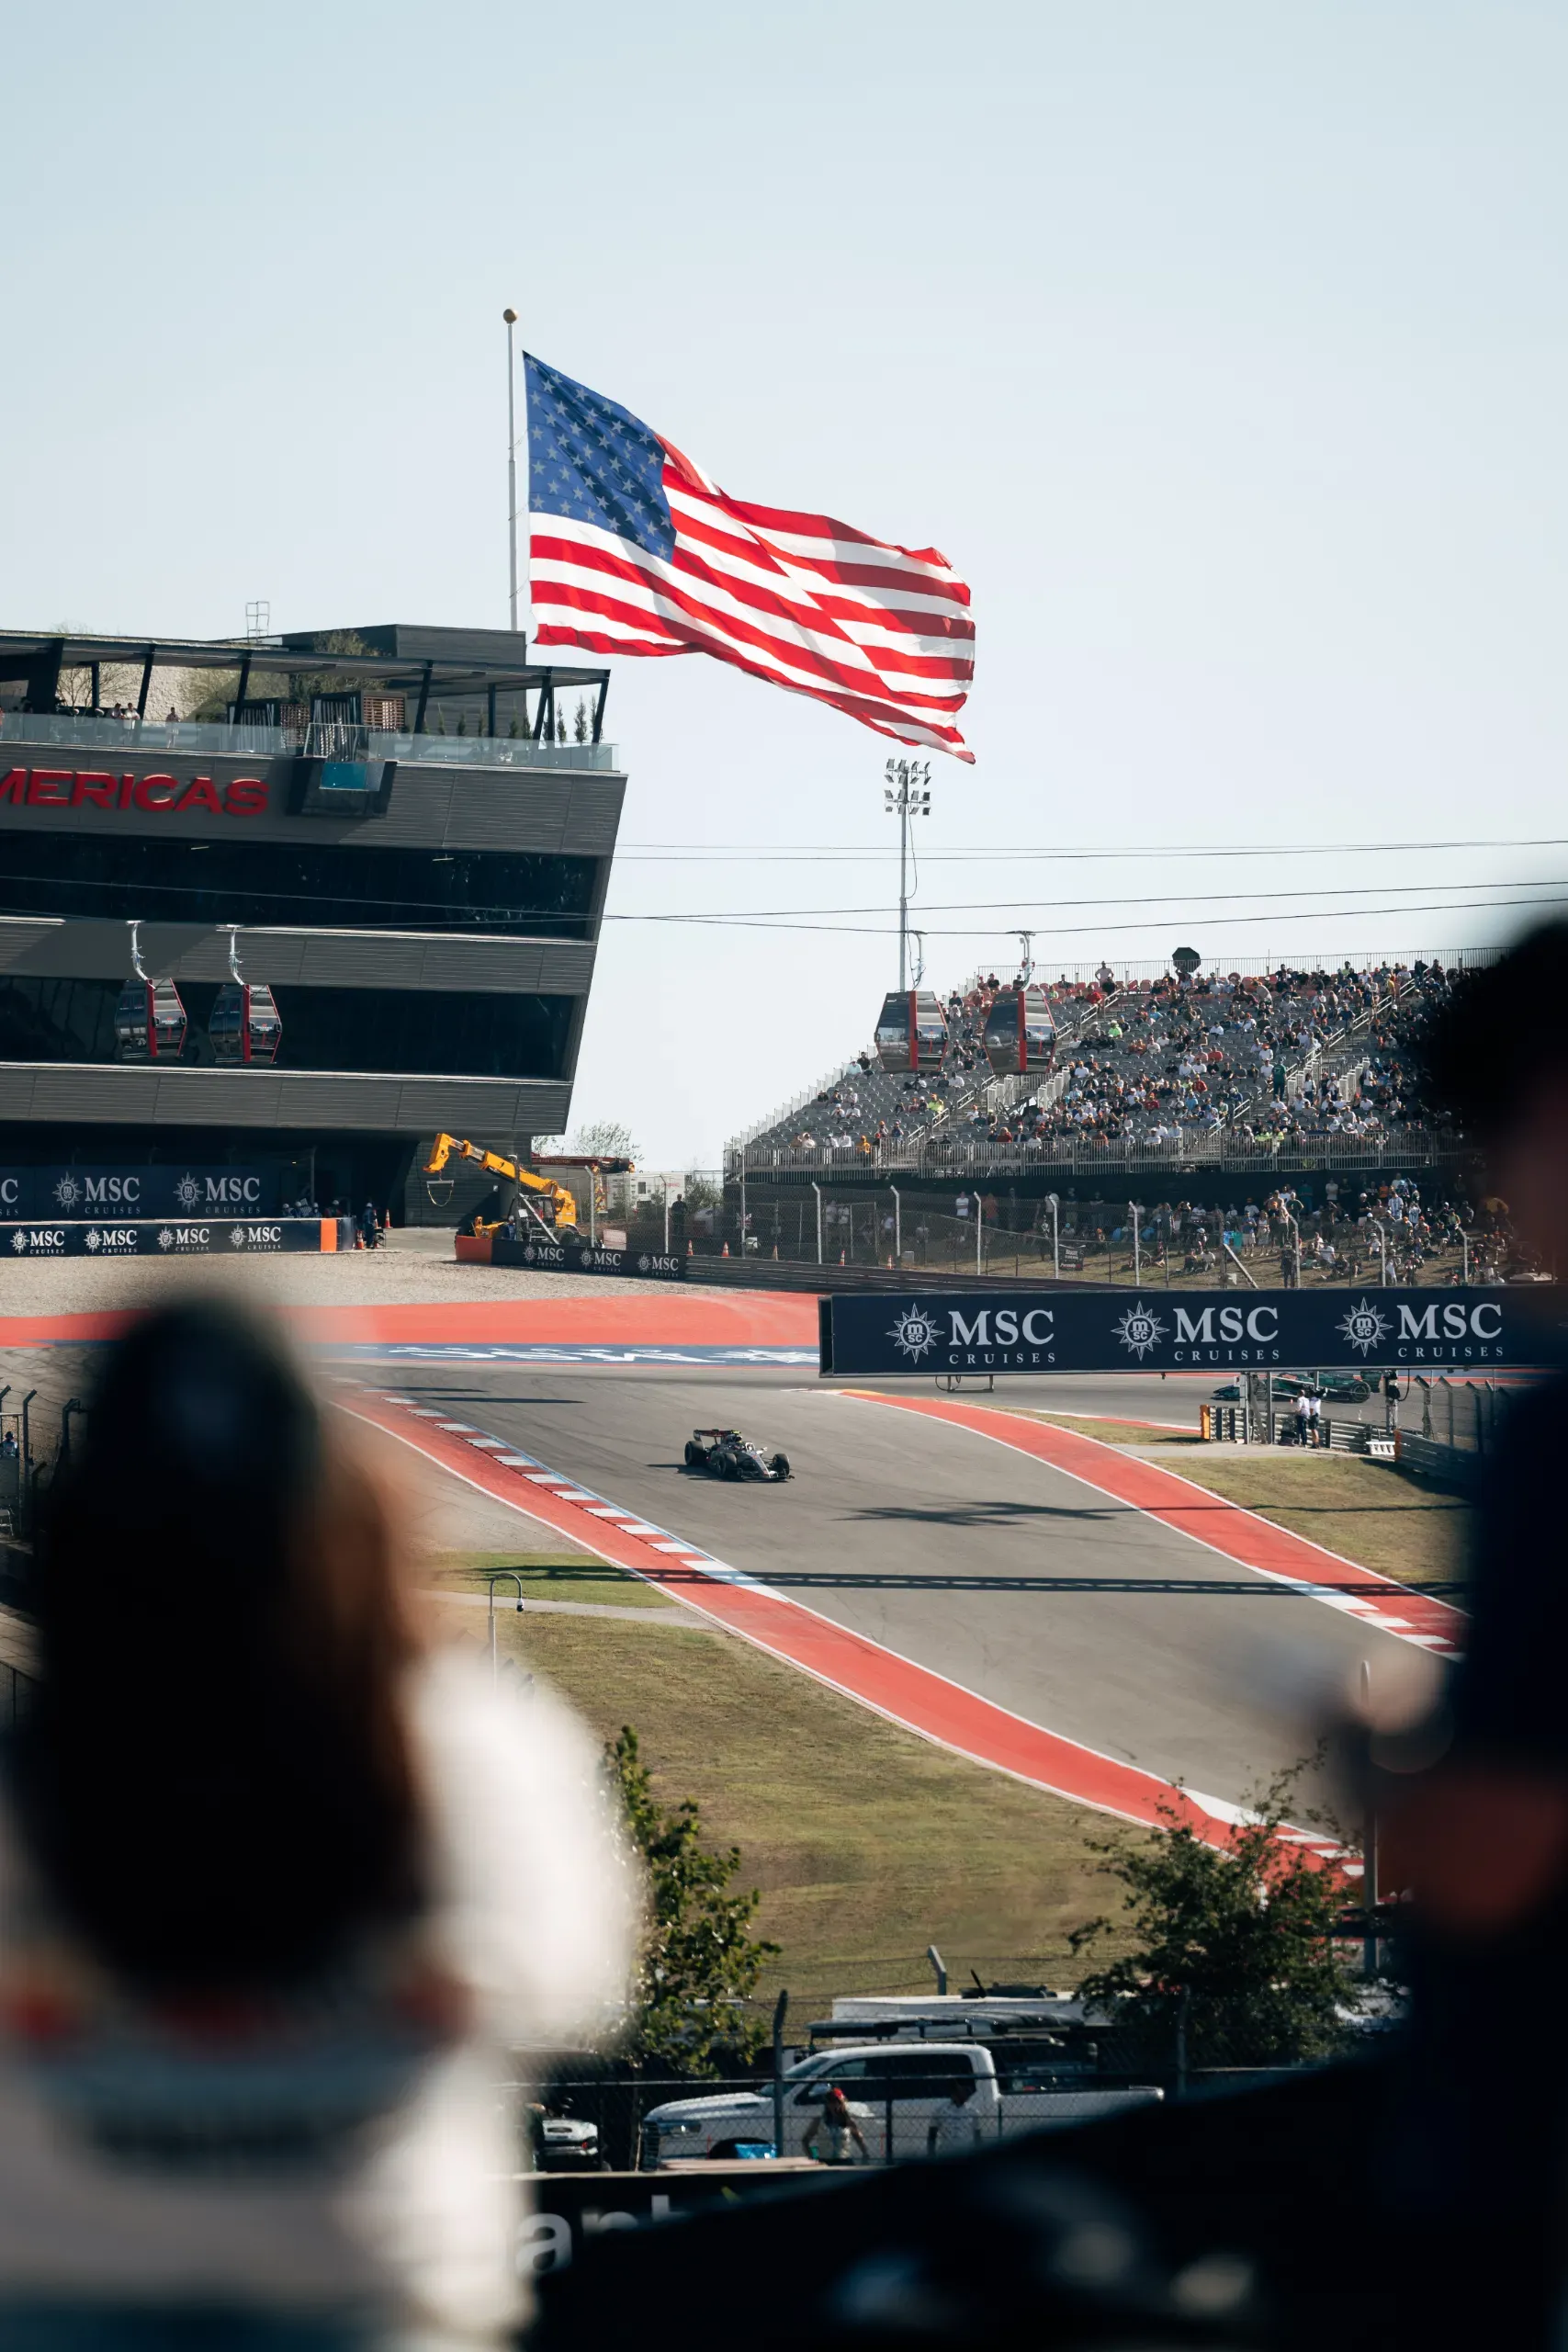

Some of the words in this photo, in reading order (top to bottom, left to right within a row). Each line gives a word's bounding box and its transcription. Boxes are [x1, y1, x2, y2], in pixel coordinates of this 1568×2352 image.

[85, 1177, 140, 1202] MSC
[205, 1177, 260, 1202] MSC
[29, 1230, 64, 1247] MSC
[102, 1229, 138, 1246] MSC
[175, 1228, 209, 1244] MSC
[247, 1227, 281, 1243] MSC
[536, 1247, 565, 1261] MSC
[593, 1251, 622, 1266] MSC
[651, 1256, 679, 1271] MSC
[948, 1309, 1055, 1346] MSC
[1173, 1306, 1279, 1343] MSC
[1396, 1303, 1502, 1340] MSC
[949, 1352, 1055, 1364] CRUISES
[1174, 1350, 1280, 1361] CRUISES
[1397, 1346, 1504, 1358] CRUISES
